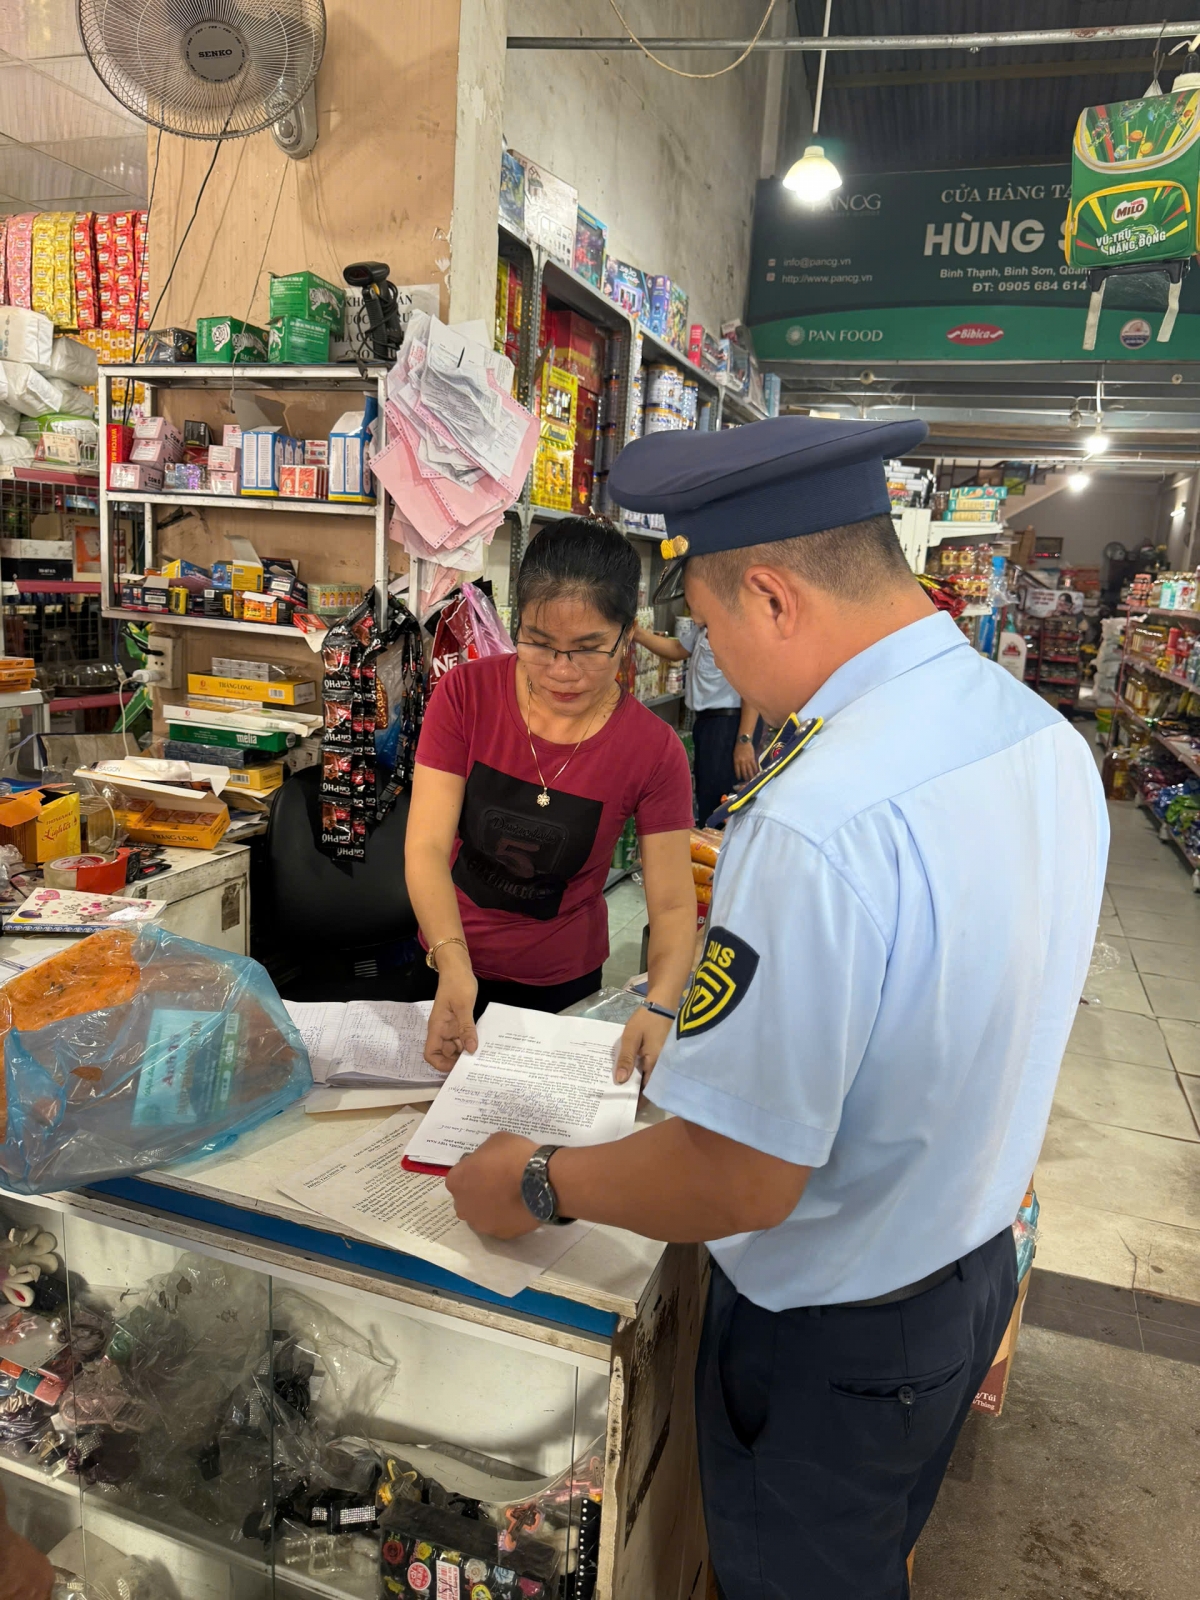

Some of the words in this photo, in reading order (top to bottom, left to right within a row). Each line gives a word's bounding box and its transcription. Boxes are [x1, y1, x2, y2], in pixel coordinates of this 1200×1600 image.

[198, 49, 233, 58] SENKO
[941, 183, 982, 204] CỬA
[987, 183, 1046, 201] HÀNG
[1116, 203, 1145, 218] MILO
[923, 211, 1046, 256] HÙNG
[783, 257, 852, 269] info@pancg.vn
[782, 274, 873, 285] http://www.pancg.vn
[972, 282, 994, 293] ĐT:
[998, 281, 1031, 292] 0905
[1034, 281, 1058, 291] 684
[1062, 280, 1087, 291] 614
[808, 330, 836, 342] PAN
[840, 329, 884, 342] FOOD
[960, 328, 991, 340] Bibica
[177, 834, 199, 842] LONG
